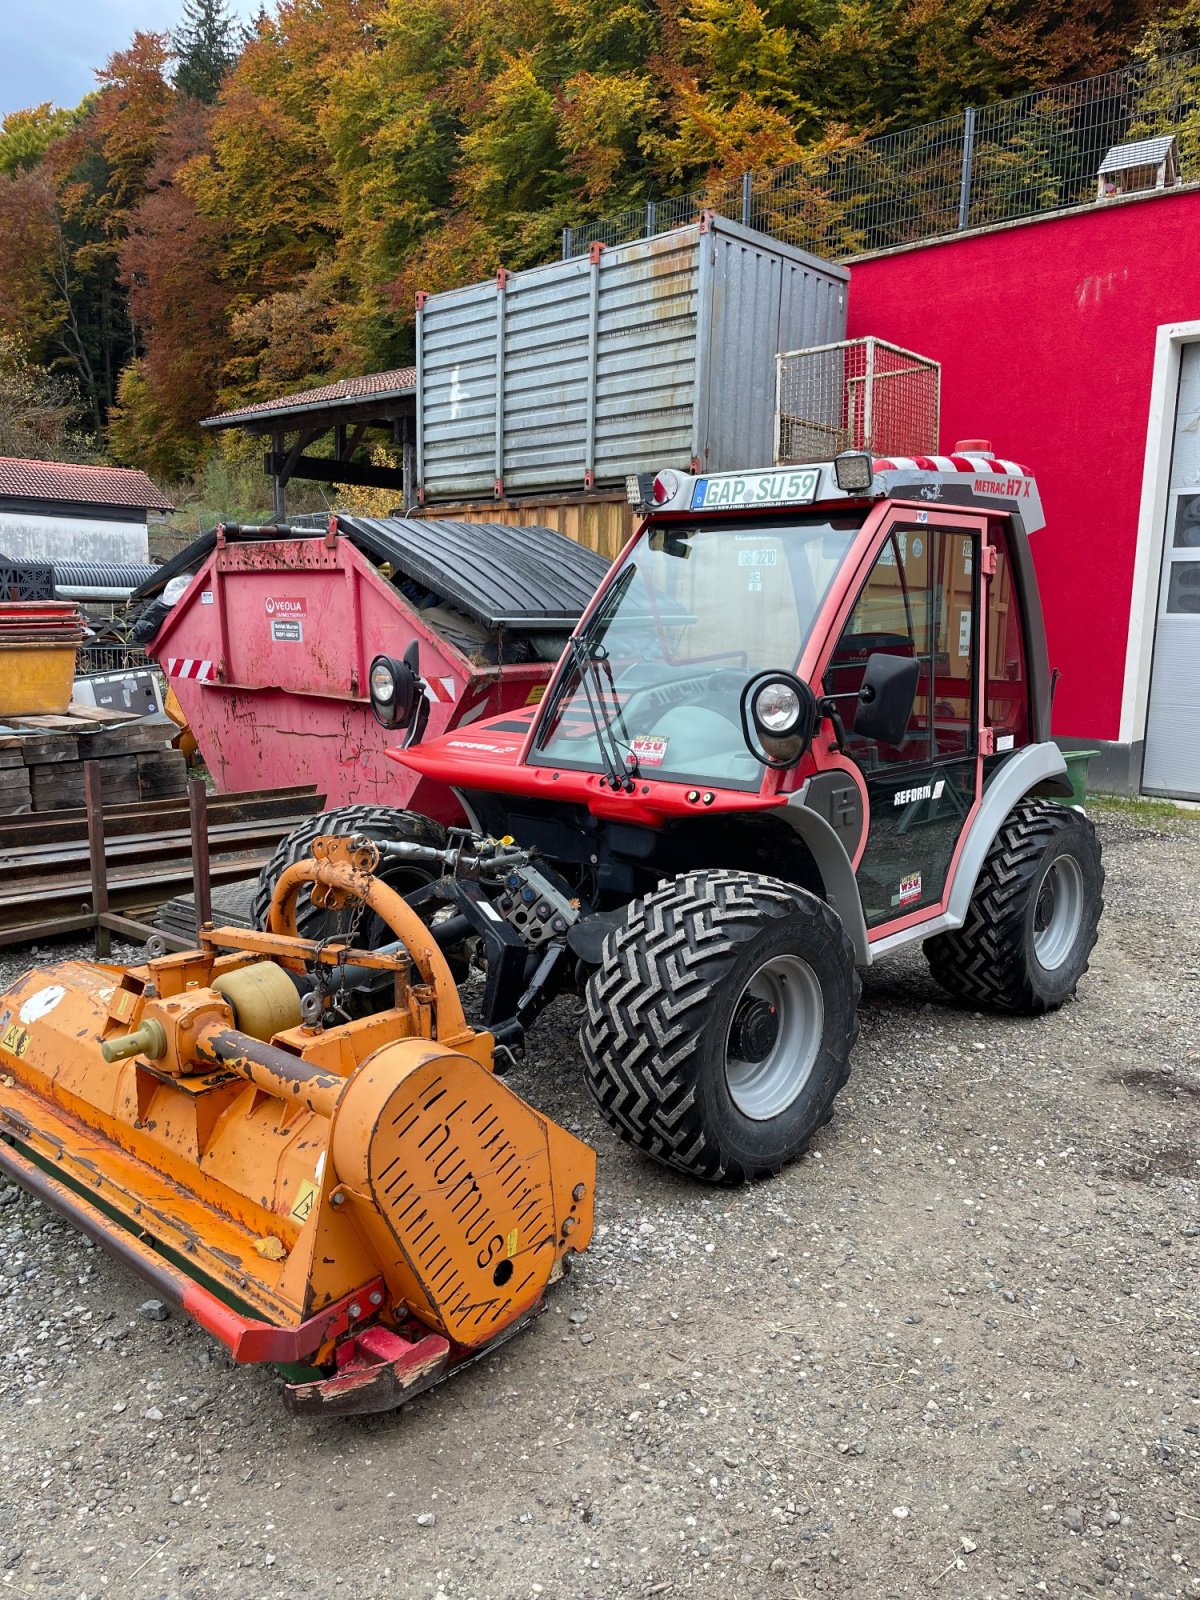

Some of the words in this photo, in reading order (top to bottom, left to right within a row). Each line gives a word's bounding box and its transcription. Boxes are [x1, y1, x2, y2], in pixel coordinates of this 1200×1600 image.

[705, 480, 746, 504] GAP
[756, 475, 785, 500] SU
[786, 474, 815, 498] 59
[974, 479, 1006, 495] METRAC
[1006, 479, 1022, 497] H7
[1023, 481, 1031, 497] X
[275, 601, 302, 611] VEOLIA
[634, 741, 663, 750] WSU
[893, 785, 932, 807] REFORM
[901, 879, 919, 892] WSU
[418, 1100, 505, 1269] humus
